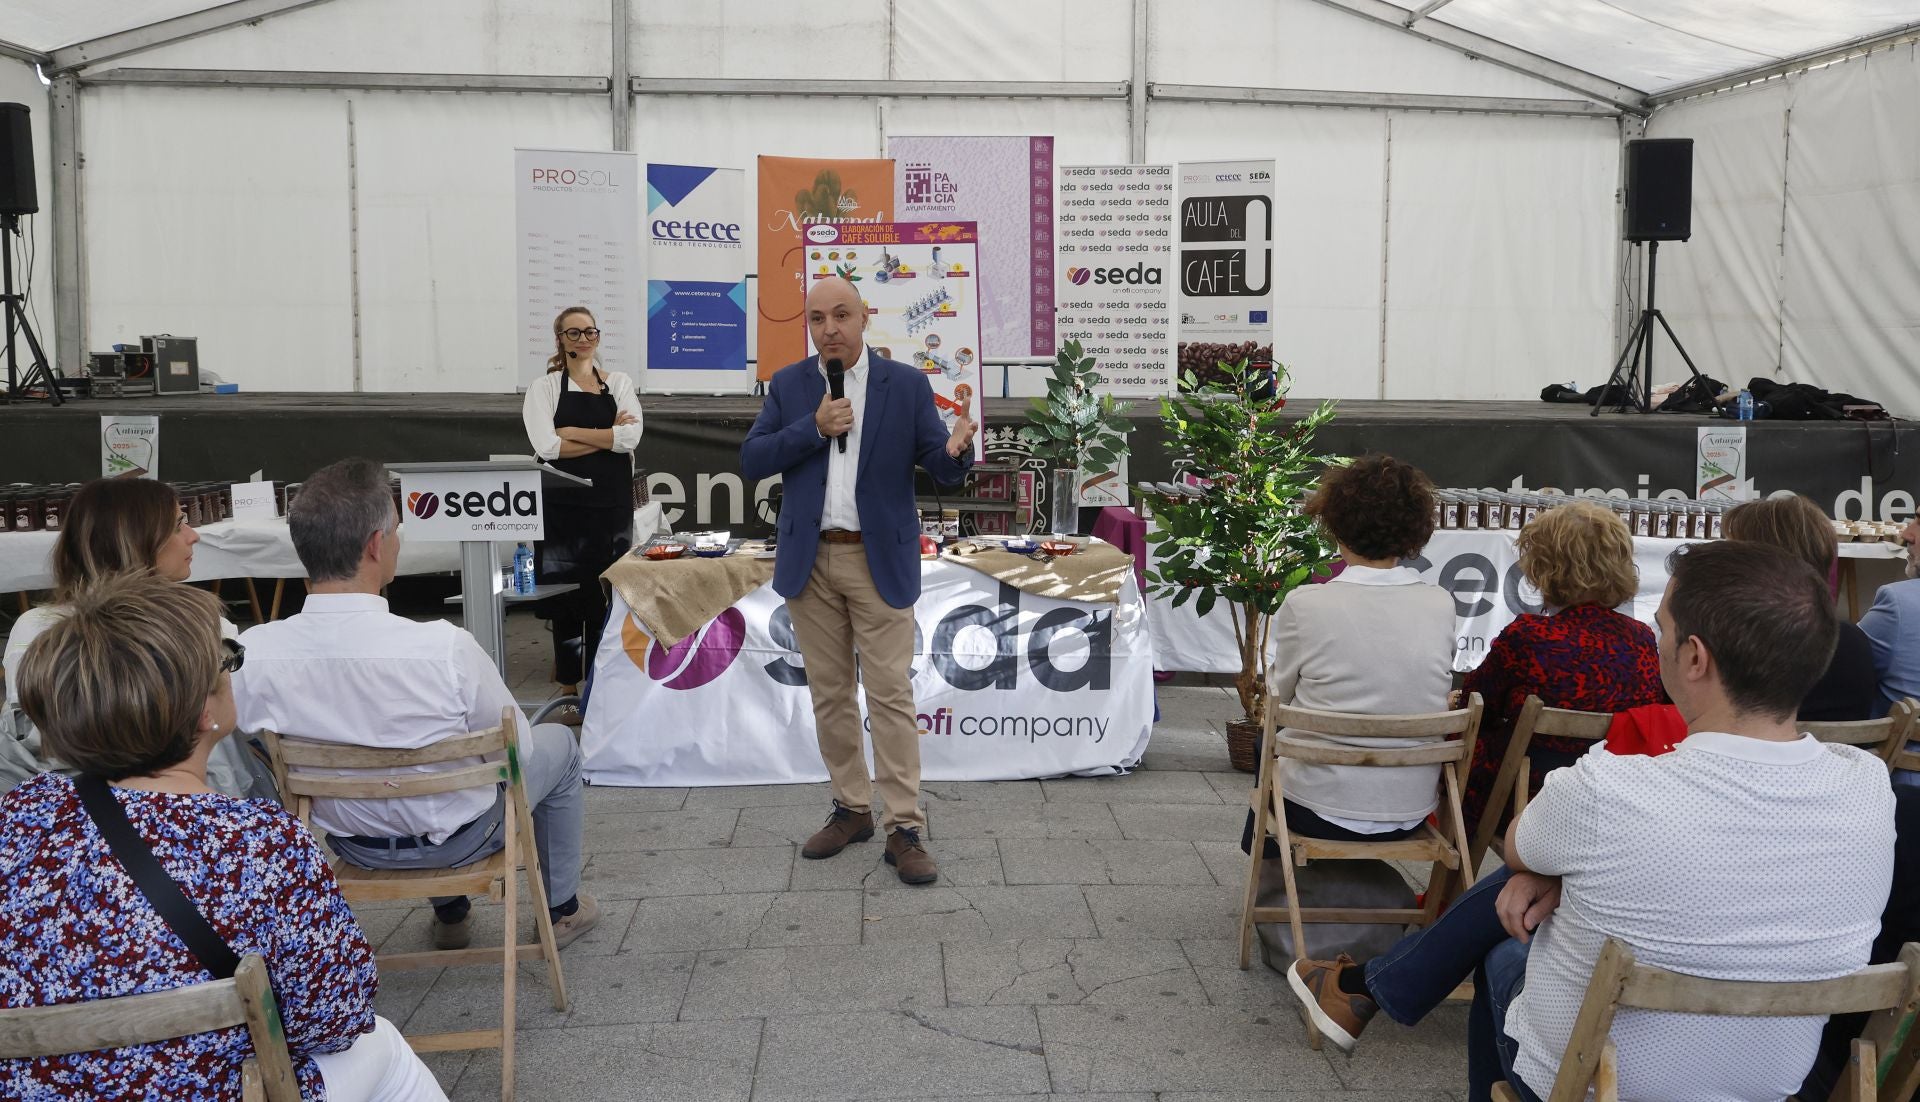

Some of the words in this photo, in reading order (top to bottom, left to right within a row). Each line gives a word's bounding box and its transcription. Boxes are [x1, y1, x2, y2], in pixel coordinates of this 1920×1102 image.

[1072, 166, 1096, 176] seda
[1109, 166, 1133, 175] seda
[1146, 166, 1170, 175] seda
[532, 168, 620, 187] PROSOL
[934, 173, 949, 182] PA
[1249, 172, 1271, 180] SEDA
[533, 185, 573, 193] PRODUCTOS
[935, 183, 958, 193] LEN
[1060, 183, 1076, 191] eda
[1089, 182, 1113, 191] seda
[1126, 182, 1150, 191] seda
[934, 193, 955, 204] CIA
[1071, 198, 1095, 206] seda
[1108, 198, 1132, 206] seda
[1145, 198, 1169, 206] seda
[1060, 213, 1076, 222] eda
[1089, 213, 1113, 221] seda
[1125, 213, 1149, 221] seda
[1185, 201, 1228, 227] AULA
[652, 219, 740, 241] cetece
[841, 224, 884, 233] ELABORACIÓN
[1071, 228, 1094, 237] seda
[1107, 228, 1131, 236] seda
[1144, 228, 1168, 236] seda
[864, 232, 900, 243] SOLUBLE
[1230, 228, 1241, 239] DEL
[1059, 244, 1075, 252] eda
[1088, 244, 1112, 252] seda
[1125, 244, 1149, 252] seda
[1094, 262, 1162, 285] seda
[1186, 251, 1240, 294] CAFÉ
[1069, 301, 1093, 309] seda
[1106, 301, 1130, 309] seda
[1143, 301, 1167, 309] seda
[1058, 316, 1074, 324] eda
[1087, 316, 1110, 324] seda
[1123, 316, 1147, 324] seda
[1069, 331, 1093, 339] seda
[1105, 331, 1129, 339] seda
[1142, 331, 1166, 339] seda
[1086, 346, 1110, 354] seda
[1122, 346, 1146, 354] seda
[1105, 361, 1128, 369] seda
[1141, 361, 1165, 370] seda
[1122, 376, 1146, 384] seda
[444, 482, 537, 517] seda
[471, 523, 483, 531] an
[484, 521, 496, 531] ofi
[497, 523, 538, 532] company
[764, 583, 1112, 692] sda
[1457, 635, 1485, 652] an
[959, 715, 1110, 743] company
